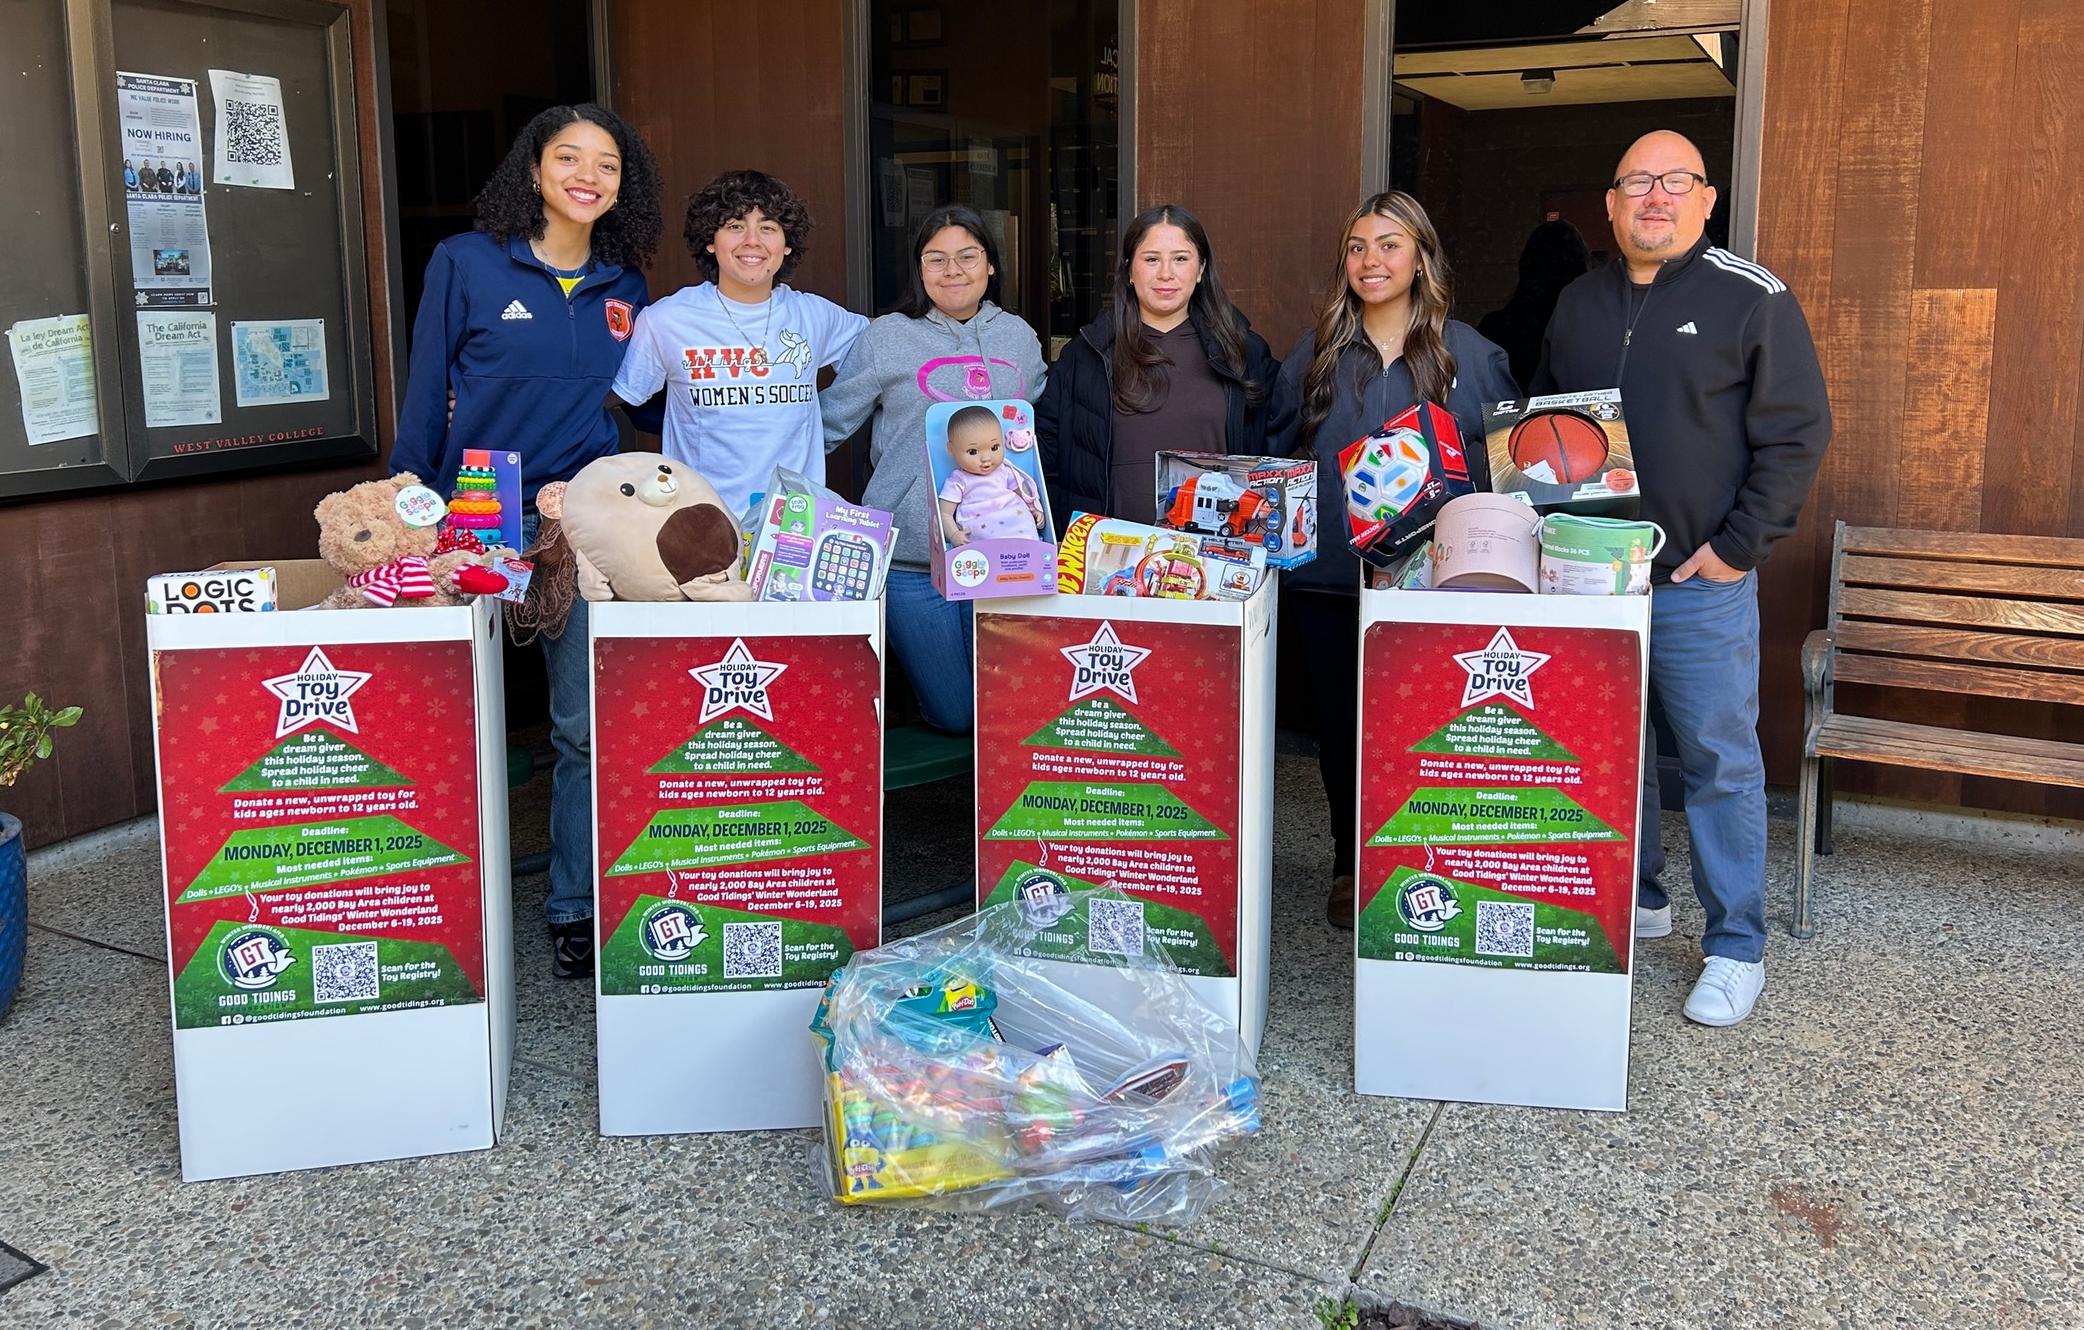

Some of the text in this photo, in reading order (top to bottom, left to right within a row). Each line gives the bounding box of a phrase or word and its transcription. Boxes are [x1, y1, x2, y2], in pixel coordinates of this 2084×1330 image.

[147, 86, 180, 94] DEPARTMENT
[127, 128, 191, 142] NOW HIRING
[501, 312, 533, 320] adidas
[20, 323, 89, 343] La ley Dream Act
[146, 321, 207, 333] The California
[32, 335, 83, 350] de California
[155, 330, 201, 341] Dream Act
[690, 386, 764, 406] WOMEN'S
[1535, 396, 1612, 406] BASKETBALL
[174, 426, 325, 453] WEST VALLEY COLLEGE
[1248, 470, 1284, 481] MAXX
[1287, 464, 1313, 478] MAXX
[1249, 478, 1284, 488] ACTION
[1287, 474, 1313, 486] ACTION
[835, 506, 870, 519] My First
[825, 512, 880, 528] Learning Tablet
[954, 559, 986, 573] Giggle
[164, 578, 254, 601] LOGIC
[1089, 645, 1123, 653] HOLIDAY
[297, 674, 338, 682] HOLIDAY
[1079, 667, 1129, 685] Drive
[1472, 674, 1526, 691] Drive
[709, 686, 764, 704] Drive
[286, 697, 347, 717] Drive
[723, 721, 735, 729] Be
[705, 730, 761, 740] dream giver
[1056, 727, 1145, 740] Spread holiday cheer
[688, 741, 705, 750] this
[707, 740, 742, 750] holiday
[1064, 738, 1073, 746] to
[1081, 739, 1102, 748] child
[1103, 740, 1112, 749] in
[1113, 742, 1136, 750] need.
[1420, 759, 1454, 768] Donate
[1464, 763, 1486, 771] new,
[1489, 764, 1544, 773] unwrapped
[1546, 766, 1562, 775] toy
[1023, 795, 1188, 820] MONDAY, DECEMBER 1, 2025
[1409, 801, 1583, 823] MONDAY, DECEMBER 1, 2025
[302, 826, 348, 836] Deadline:
[649, 820, 827, 839] MONDAY, DECEMBER 1, 2025
[1115, 829, 1148, 837] Pokémon
[1155, 829, 1177, 838] Sports
[1178, 829, 1216, 838] Equipment
[224, 834, 422, 860] MONDAY, DECEMBER 1, 2025
[695, 838, 781, 852] Most needed items:
[1452, 869, 1592, 884] Good Tidings' Winter Wonderland
[748, 899, 842, 910] December 6-19, 2025
[1416, 890, 1437, 910] GT
[1394, 933, 1459, 947] GOOD TIDINGS
[239, 941, 264, 966] GT
[381, 961, 436, 973] Scan for the
[639, 964, 707, 976] GOOD TIDINGS
[381, 969, 440, 982] Toy Registry!
[219, 990, 296, 1006] GOOD TIDINGS
[245, 998, 444, 1023] @goodtidingsfoundation www.goodtidings.org
